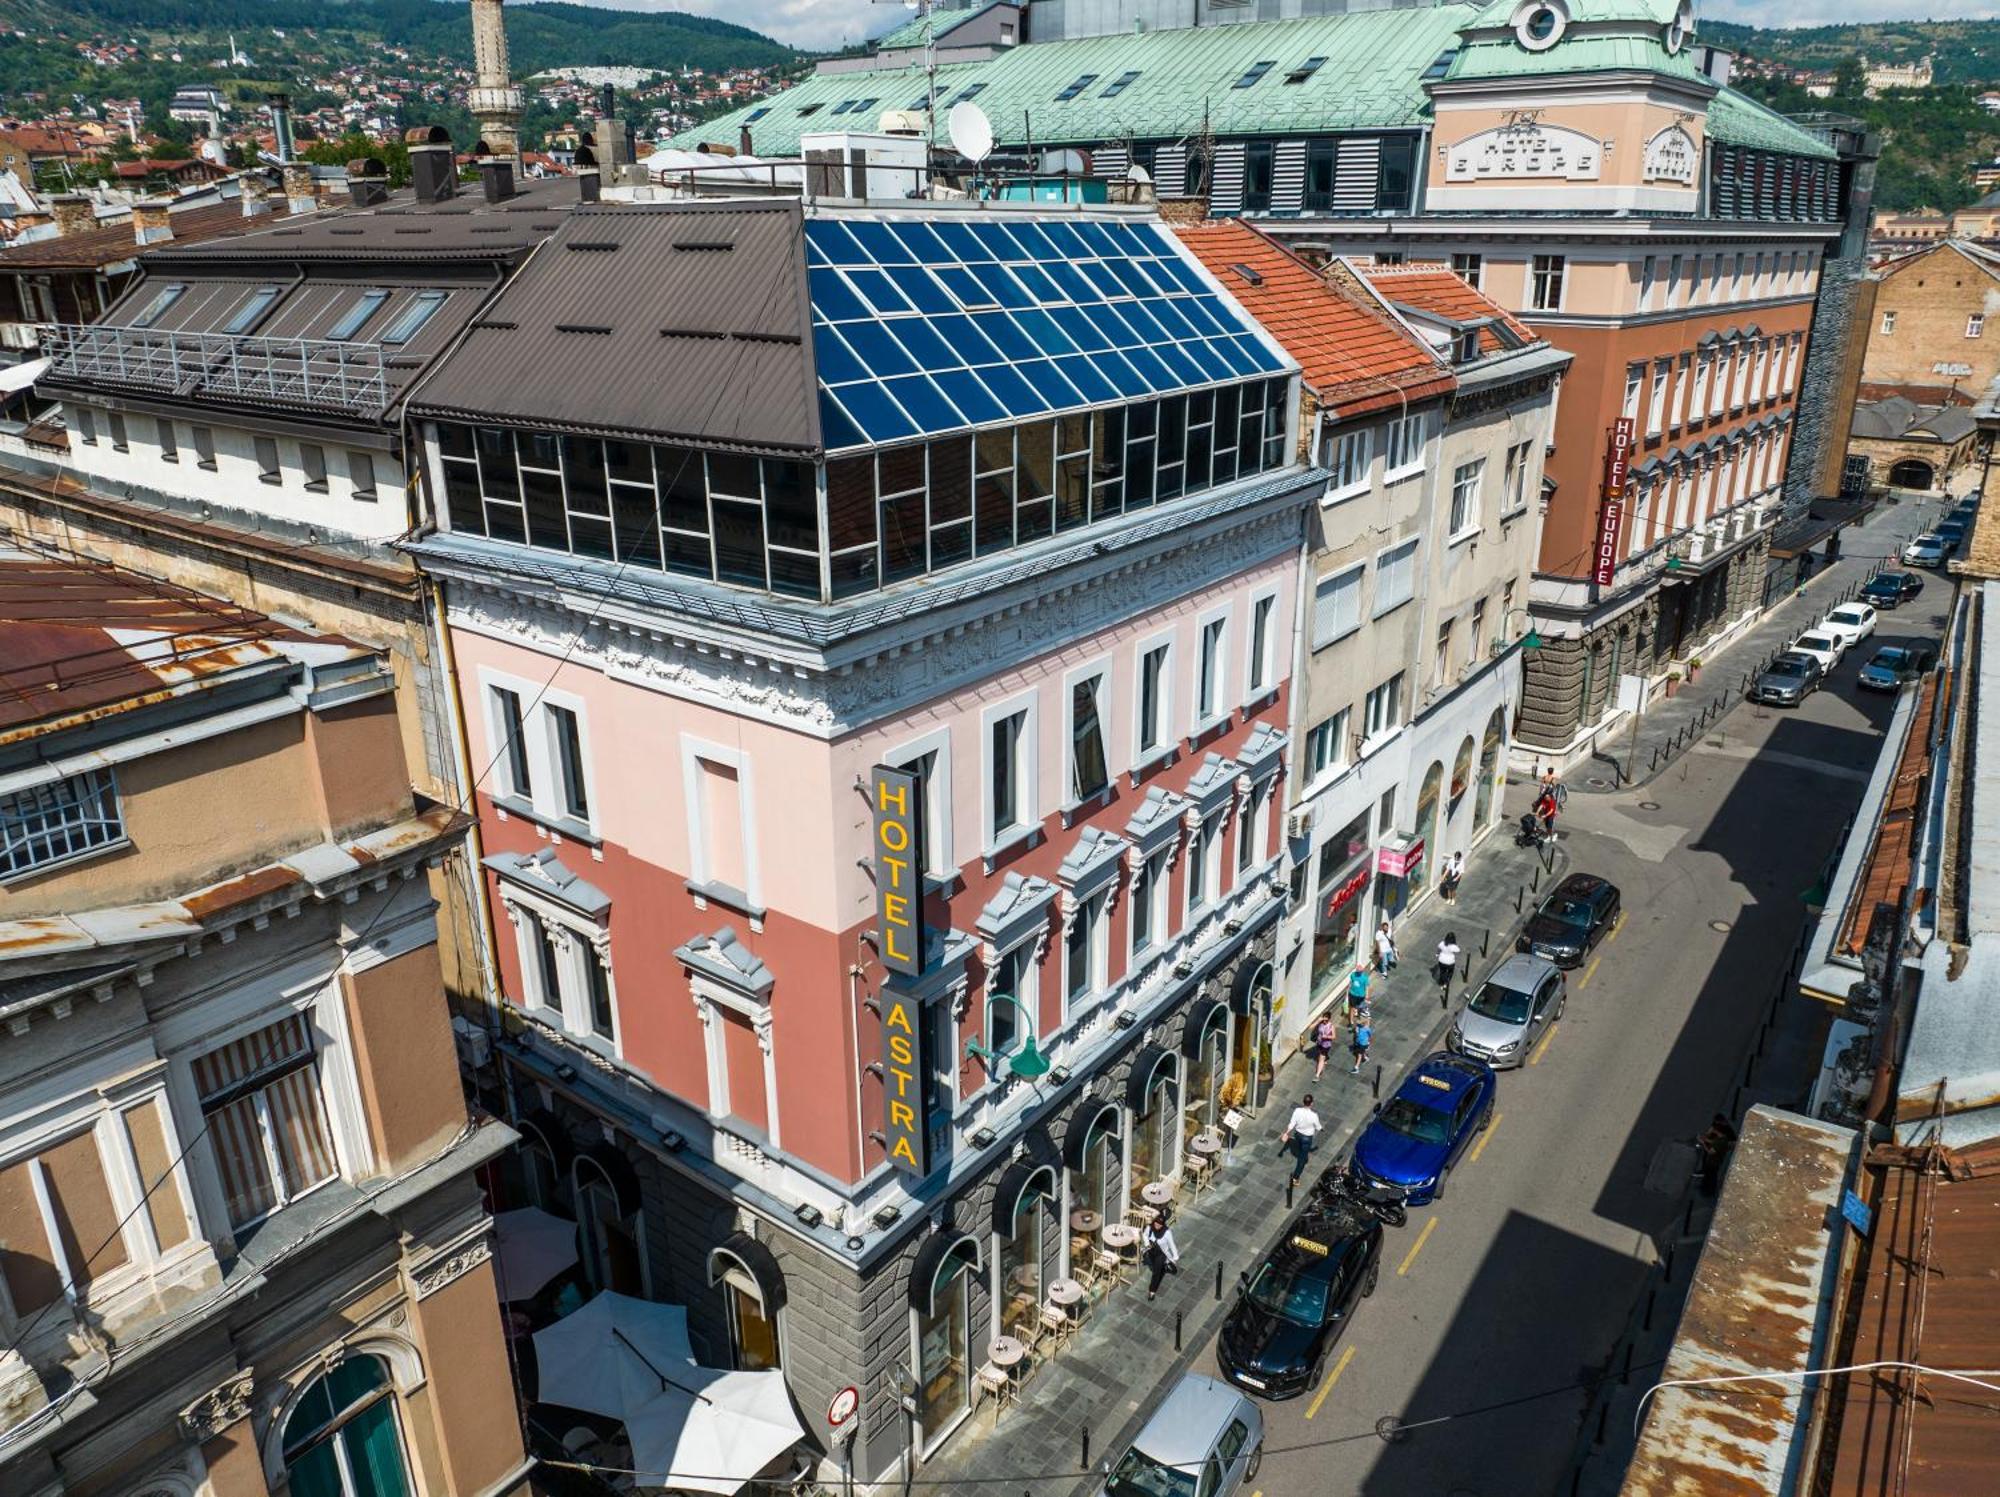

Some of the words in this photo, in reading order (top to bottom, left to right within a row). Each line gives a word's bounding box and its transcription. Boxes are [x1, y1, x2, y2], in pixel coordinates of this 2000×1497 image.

[1454, 157, 1592, 173] EUROPE
[1484, 139, 1562, 154] HOTEL
[1612, 420, 1630, 488] HOTEL
[1598, 505, 1619, 584] EUROPE
[878, 781, 910, 963] HOTEL
[887, 1002, 917, 1168] ASTRA
